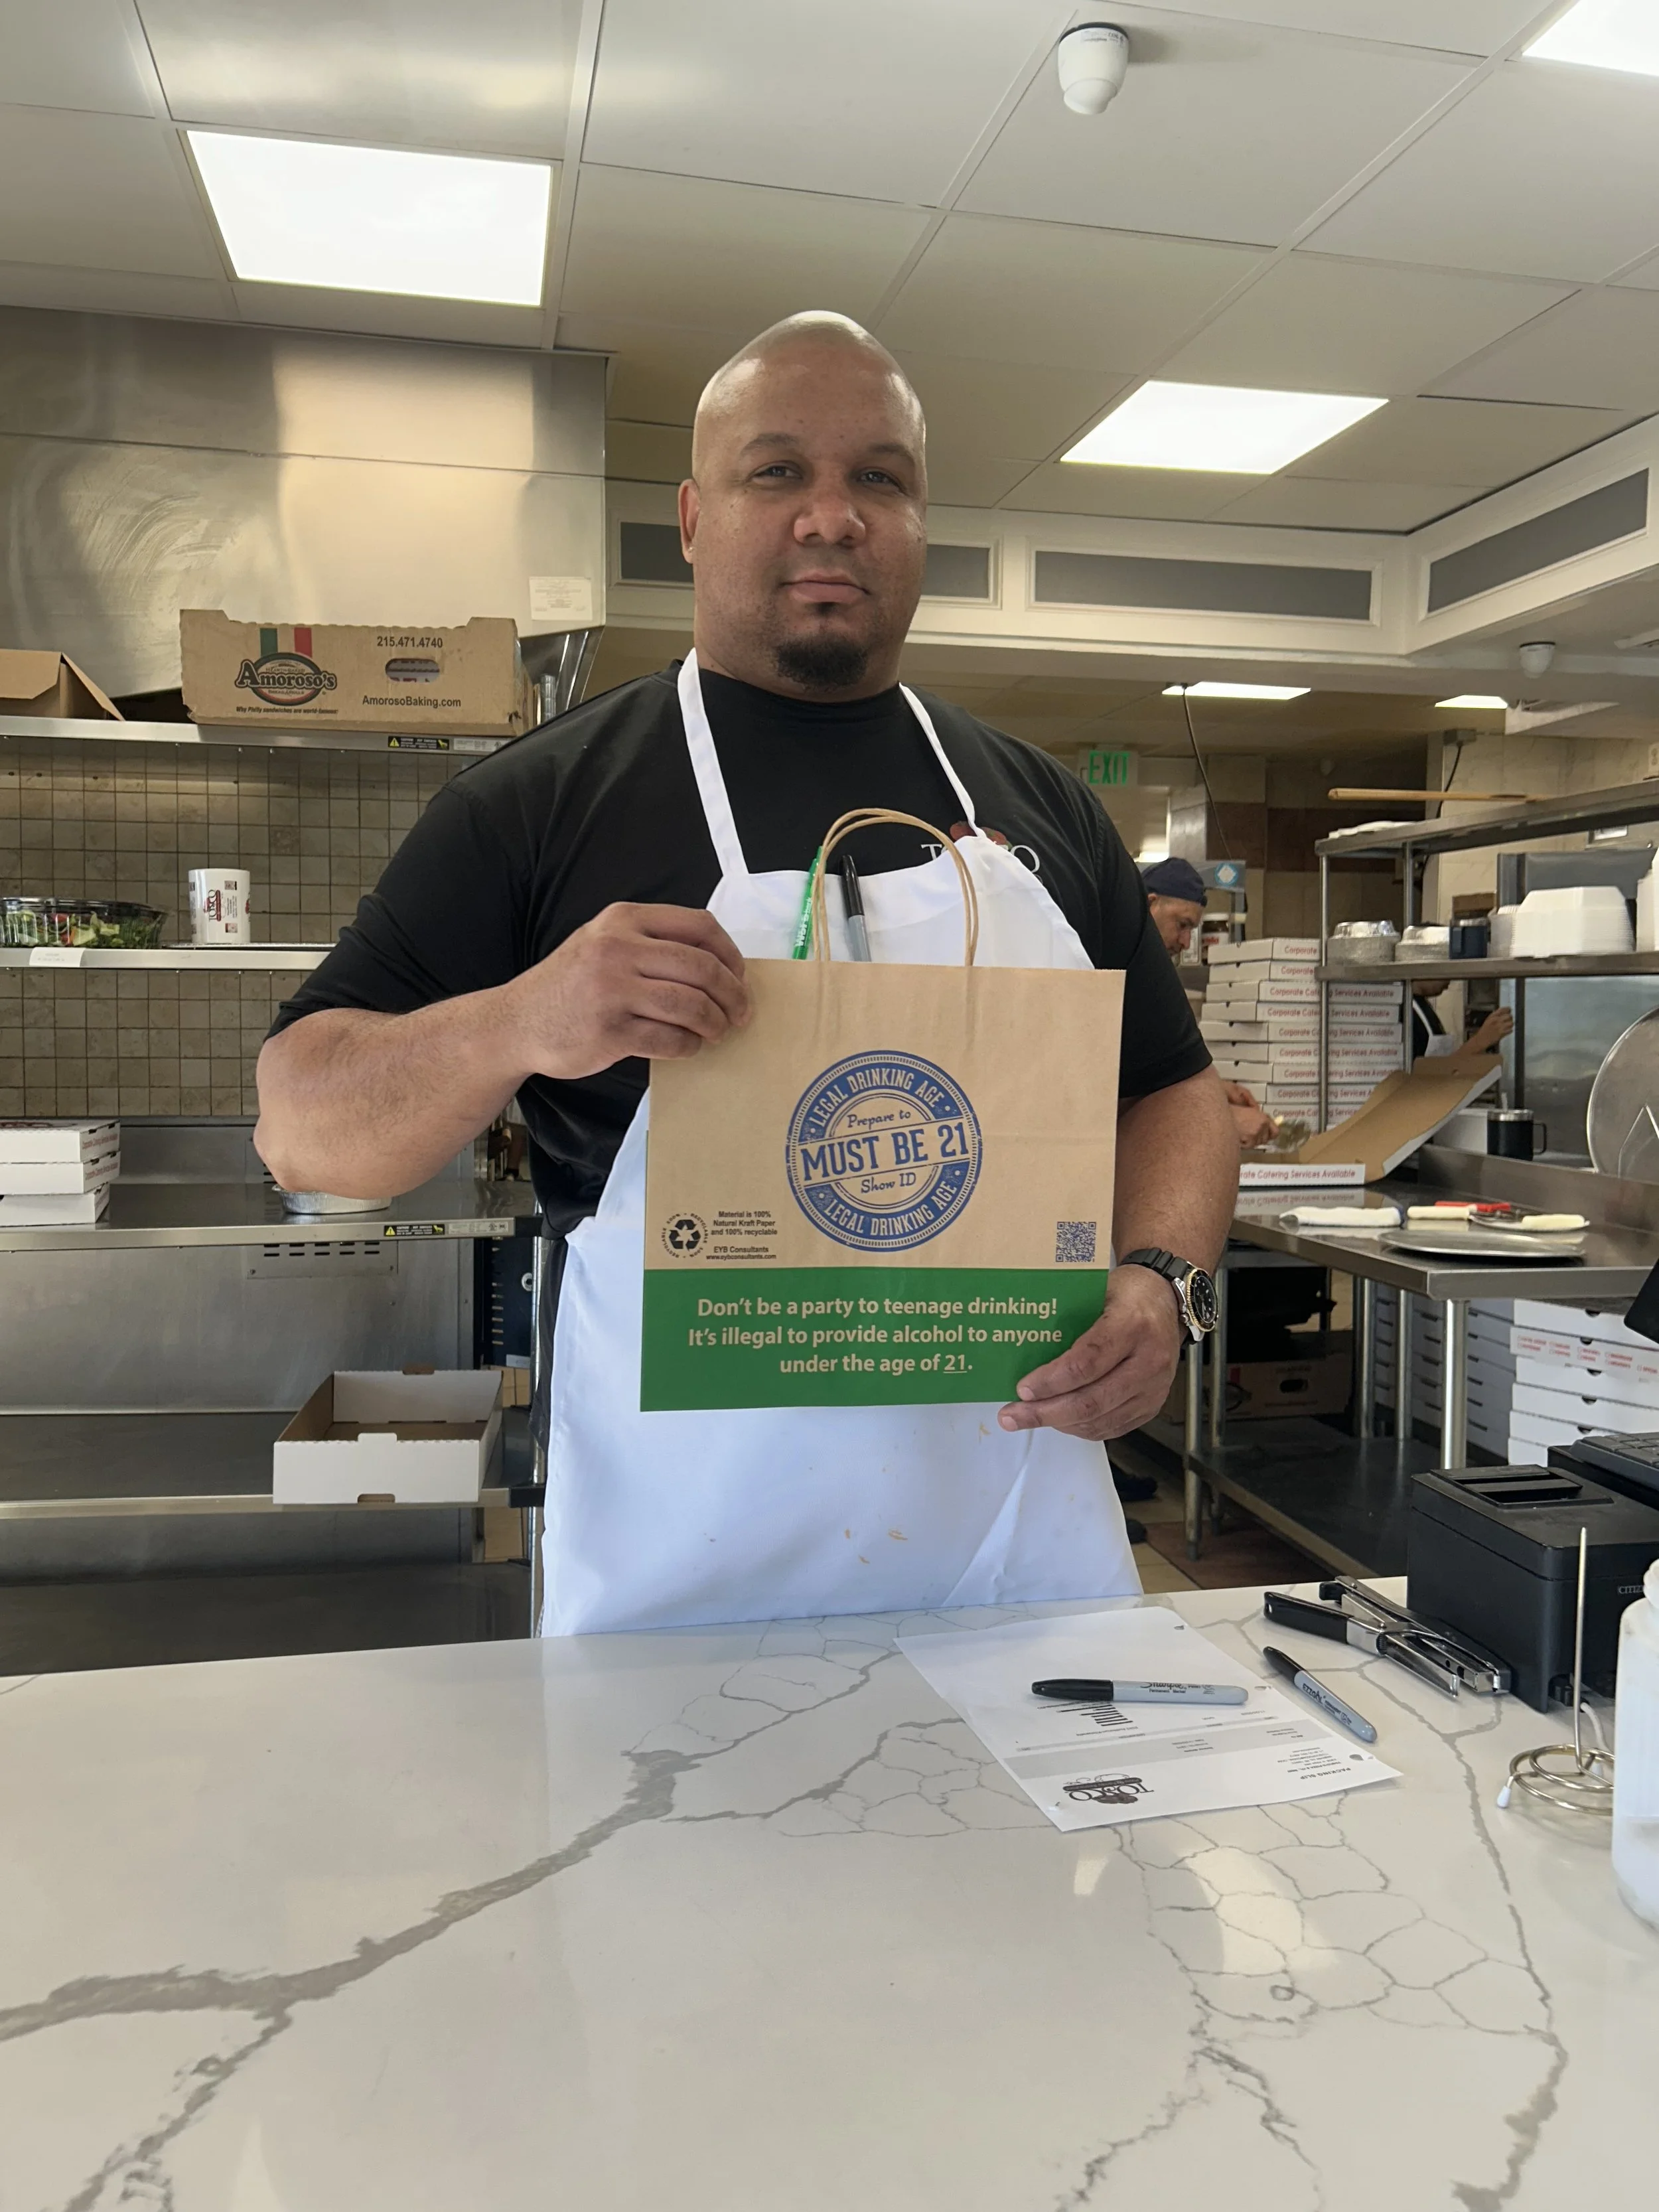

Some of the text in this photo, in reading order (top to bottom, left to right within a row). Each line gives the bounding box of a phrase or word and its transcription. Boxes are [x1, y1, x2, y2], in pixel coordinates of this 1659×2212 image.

[377, 636, 443, 648] 215.471.4740
[236, 660, 337, 690] Amoroso's
[362, 696, 461, 709] AmorosoBaking.com
[1089, 751, 1131, 785] EXIT
[1285, 946, 1317, 956] Corporate
[1269, 987, 1303, 997] Corporate
[1335, 988, 1361, 997] Services
[1267, 1007, 1301, 1017] Corporate
[1279, 1027, 1310, 1036] Corporate
[1279, 1048, 1311, 1057] Corporate
[1284, 1069, 1316, 1078] Corporate
[810, 1068, 945, 1127] LEGAL DRINKING AGE
[1277, 1089, 1310, 1098] Corporate
[1273, 1108, 1305, 1117] Corporate
[847, 1110, 911, 1130] Prepare to
[800, 1122, 969, 1181] MUST BE 21
[1258, 1169, 1289, 1181] Catering
[1291, 1170, 1321, 1179] Services
[1322, 1169, 1355, 1178] Available
[861, 1172, 916, 1193] Show ID
[824, 1181, 958, 1236] LEGAL DRINKING AGE
[757, 1297, 782, 1315] be
[786, 1301, 798, 1314] a
[802, 1298, 854, 1319] party
[858, 1298, 879, 1314] to
[883, 1299, 964, 1319] teenage
[968, 1297, 1057, 1319] drinking!
[722, 1326, 782, 1349] illegal
[787, 1327, 808, 1343] to
[812, 1325, 888, 1347] provide
[893, 1325, 963, 1343] alcohol
[967, 1327, 987, 1342] to
[991, 1329, 1062, 1347] anyone
[780, 1353, 973, 1376] under the age of 21.
[1317, 1767, 1351, 1777] PACKING
[1069, 1782, 1155, 1801] TOSCO
